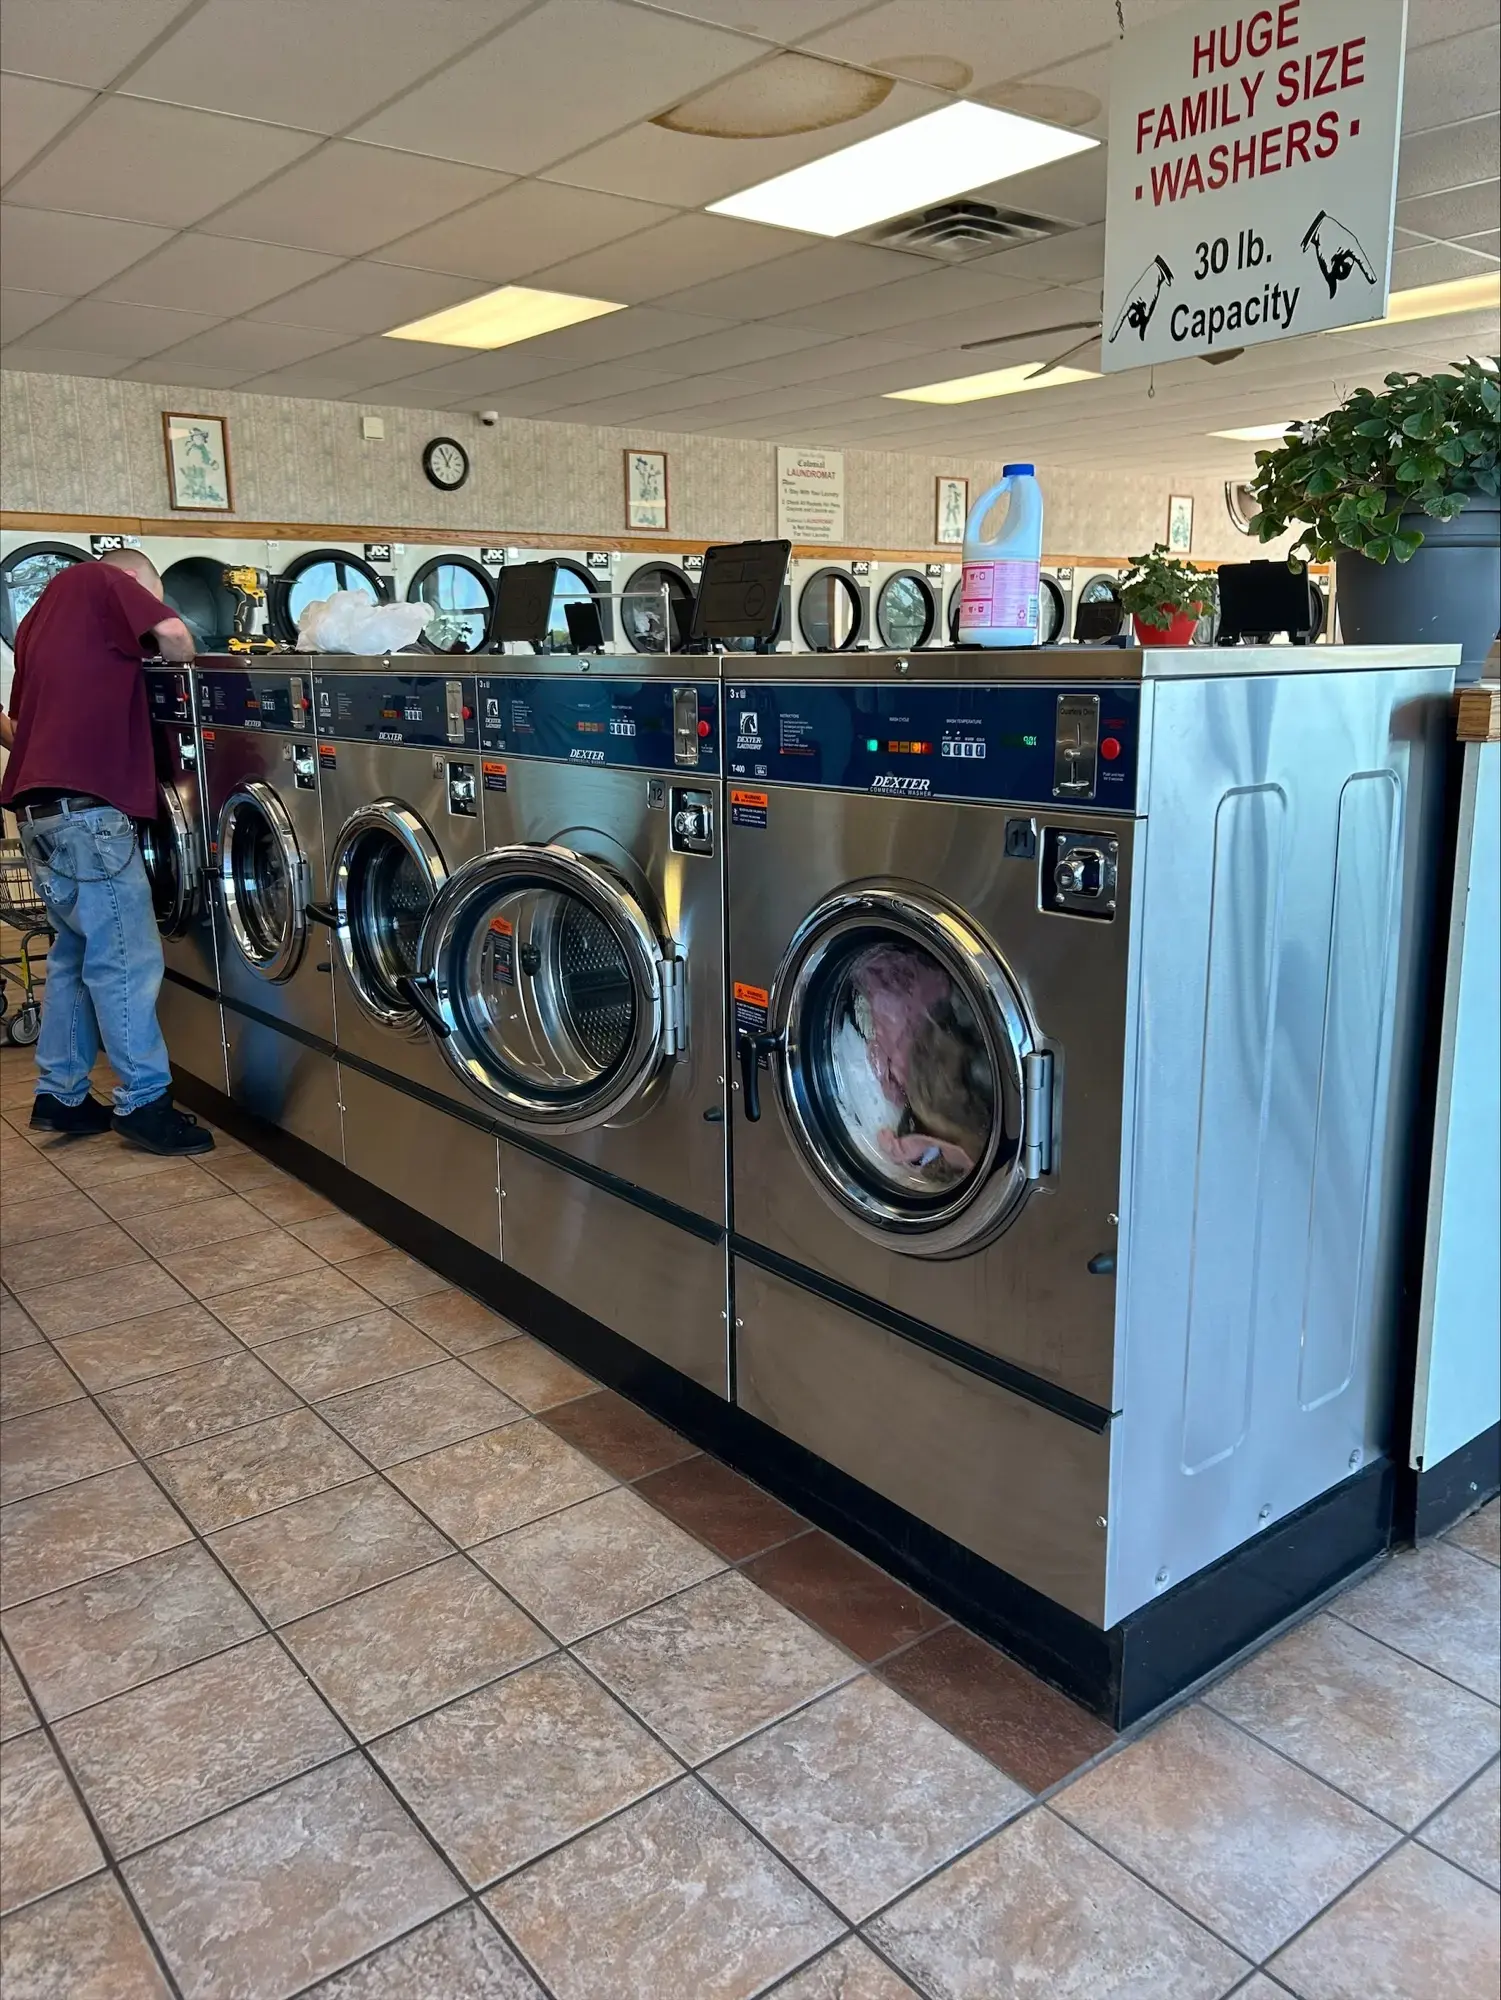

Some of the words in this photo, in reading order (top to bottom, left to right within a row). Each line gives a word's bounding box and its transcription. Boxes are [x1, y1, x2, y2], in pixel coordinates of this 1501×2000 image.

[1192, 0, 1300, 78] HUGE
[1136, 70, 1265, 154] FAMILY
[1276, 36, 1366, 108] SIZE
[1150, 110, 1339, 206] WASHERS
[1194, 237, 1229, 281] 30
[1237, 228, 1272, 271] lb.
[1170, 282, 1300, 345] Capacity
[786, 468, 836, 480] LAUNDROMAT
[379, 732, 403, 741] DEXTER
[736, 736, 762, 744] DEXTER
[569, 748, 605, 761] DEXTER
[436, 761, 443, 773] 13
[731, 764, 746, 773] T-400
[871, 775, 931, 791] DEXTER
[651, 787, 663, 802] 12
[869, 786, 906, 795] COMMERCIAL
[907, 789, 932, 797] WASHER
[1011, 829, 1029, 848] 11
